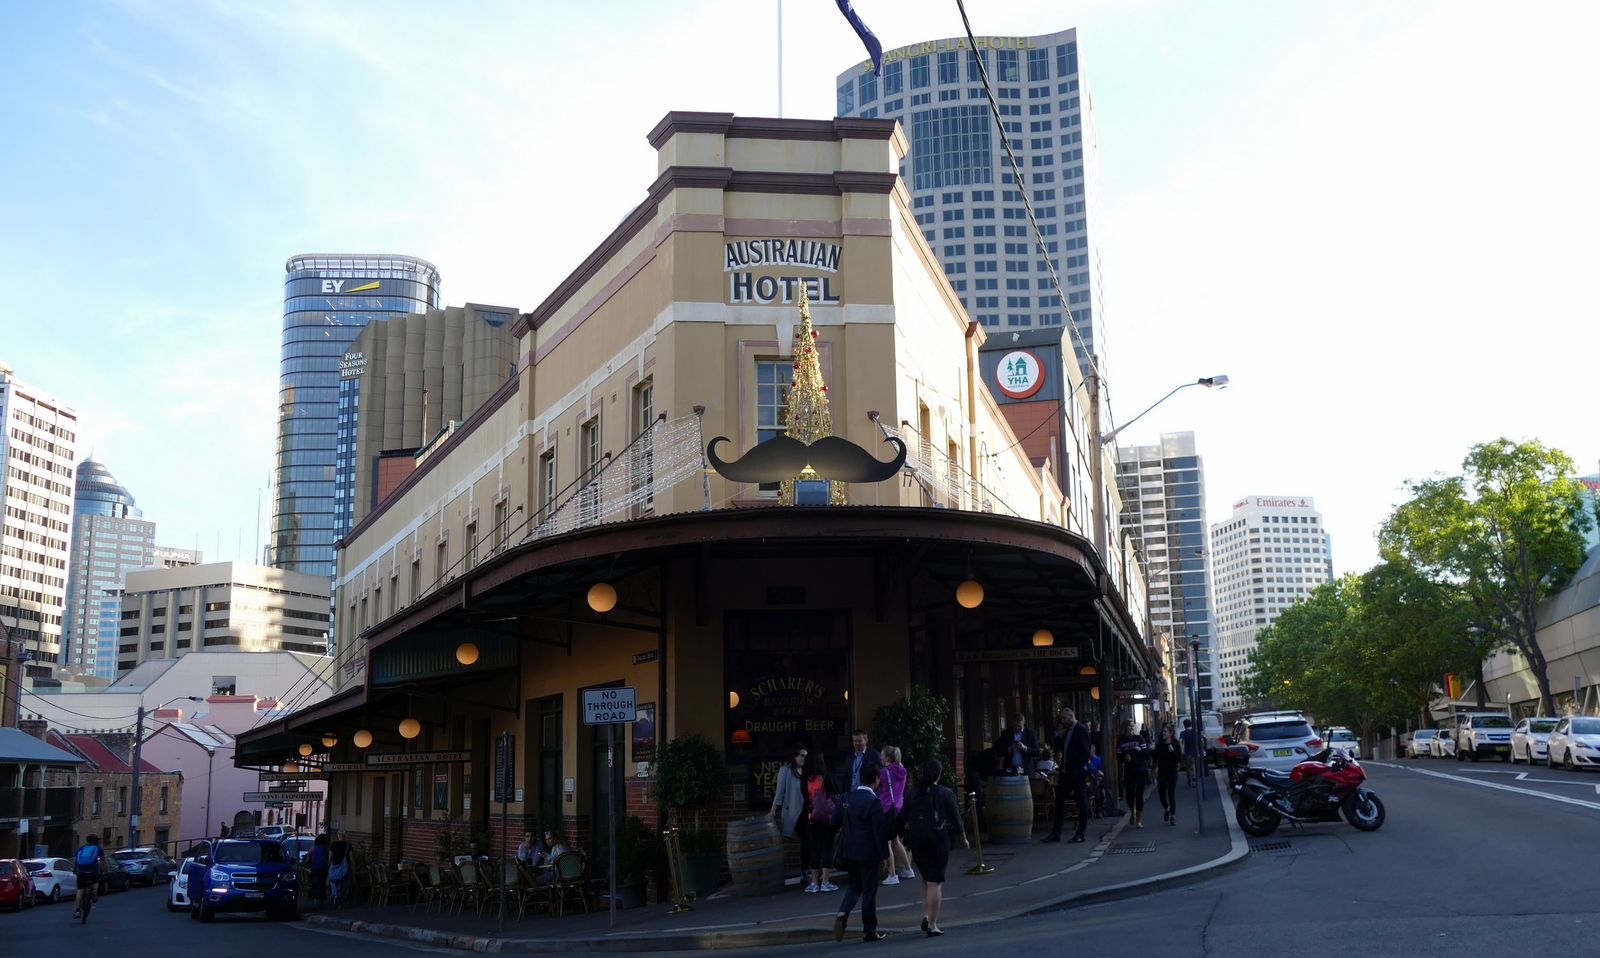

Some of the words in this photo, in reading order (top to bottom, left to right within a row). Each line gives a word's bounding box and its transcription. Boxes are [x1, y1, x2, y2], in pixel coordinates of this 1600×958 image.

[863, 37, 968, 72] SANGRI-LA
[976, 36, 1036, 50] HOTEL
[724, 238, 843, 273] AUSTRALIAN
[322, 280, 345, 293] EY
[730, 272, 841, 305] HOTEL
[345, 352, 363, 361] FOUR
[339, 359, 368, 369] SEASONS
[341, 367, 365, 377] HOTEL
[1007, 376, 1029, 385] YHA
[1256, 497, 1296, 508] Emirates
[1032, 649, 1048, 658] THE
[1049, 648, 1076, 657] ROCKS
[750, 676, 826, 701] SCHARER'S
[602, 690, 617, 700] NO
[587, 700, 633, 711] THROUGH
[764, 697, 814, 707] BAVARIAN
[595, 711, 626, 721] ROAD
[773, 707, 805, 716] STYLE
[745, 720, 798, 732] DRAUGHT
[805, 719, 835, 731] BEER
[375, 755, 429, 763] AUSTRALIAN
[436, 753, 464, 761] HOTEL
